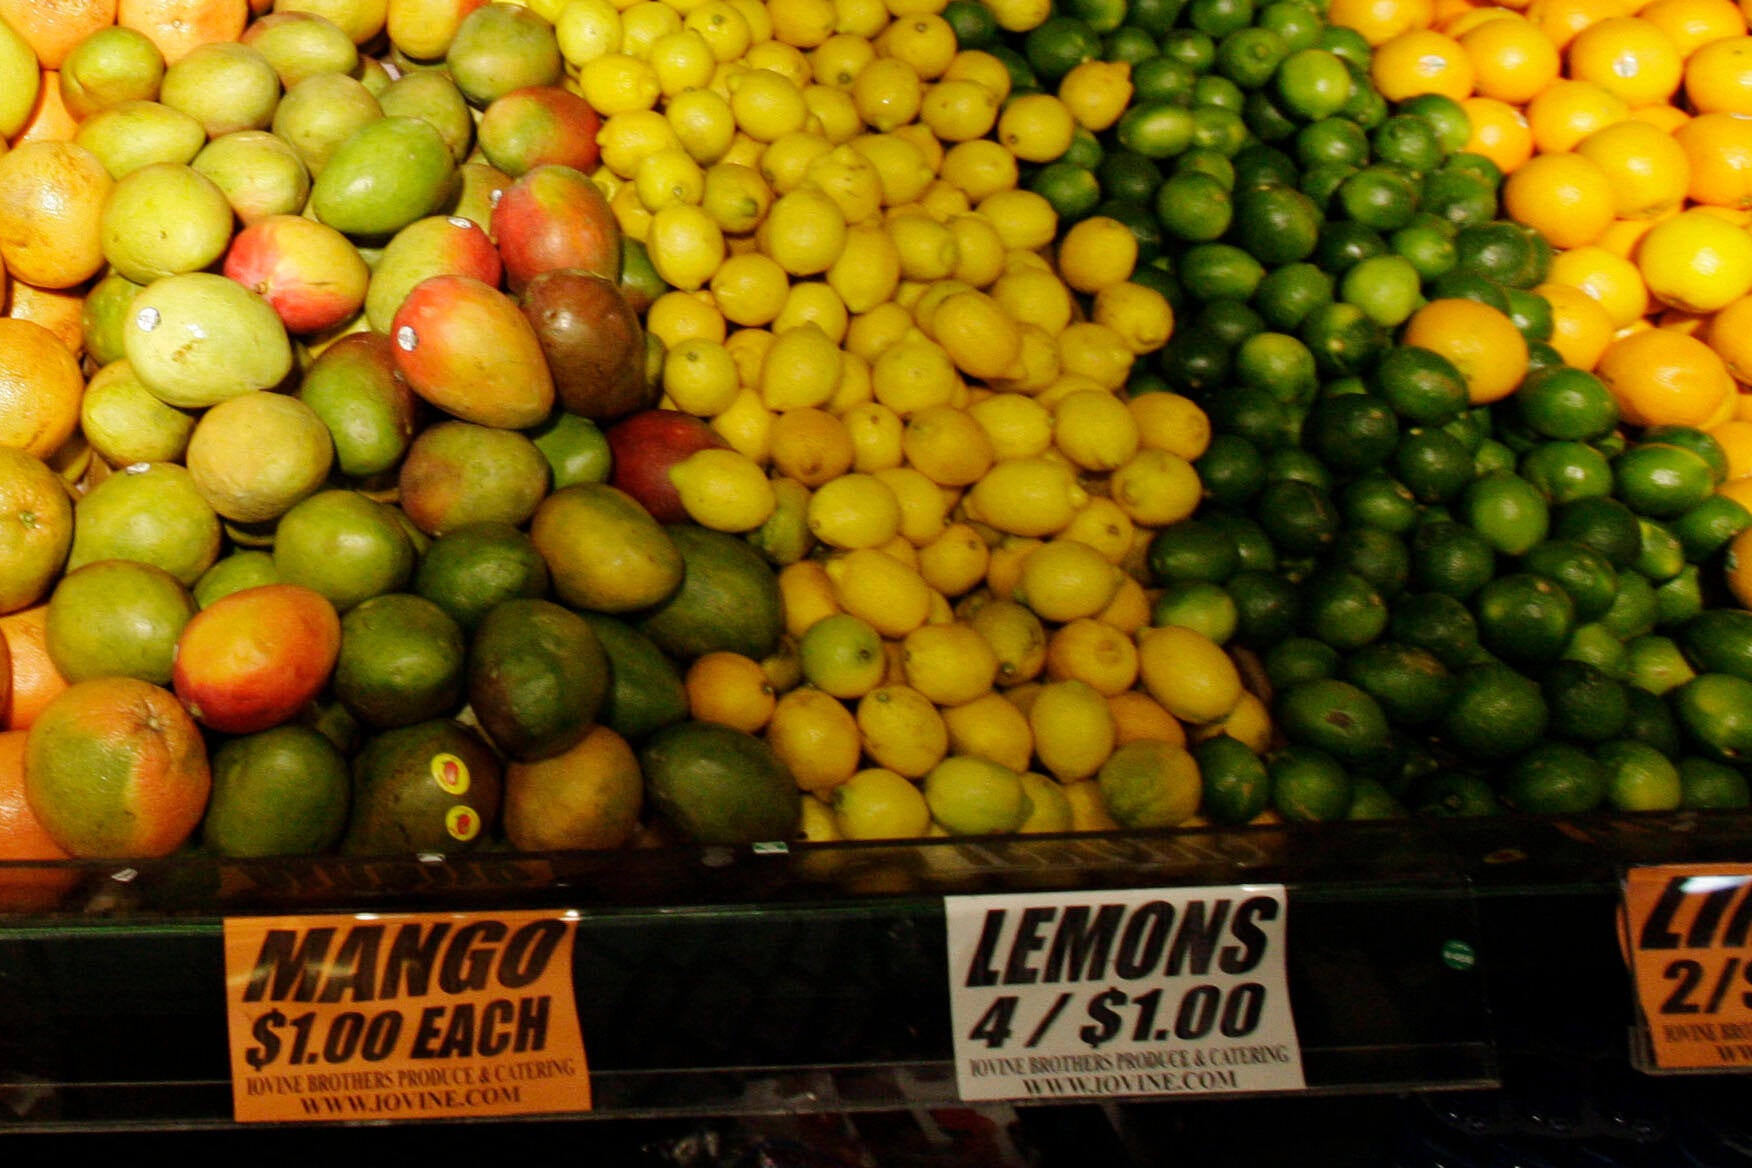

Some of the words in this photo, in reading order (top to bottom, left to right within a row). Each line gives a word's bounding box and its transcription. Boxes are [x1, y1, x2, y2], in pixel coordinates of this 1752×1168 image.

[965, 895, 1280, 988] LEMONS
[1639, 874, 1752, 950] LI
[241, 918, 568, 1005] MANGO
[244, 1007, 406, 1073] $1.00
[409, 995, 552, 1060] EACH
[1079, 982, 1268, 1050] $1.00
[306, 1069, 395, 1093] BROTHERS
[397, 1066, 474, 1089] PRODUCE
[494, 1057, 576, 1082] CATERING
[1028, 1053, 1114, 1075] BROTHERS
[1115, 1049, 1190, 1073] PRODUCE
[1208, 1043, 1290, 1066] CATERING
